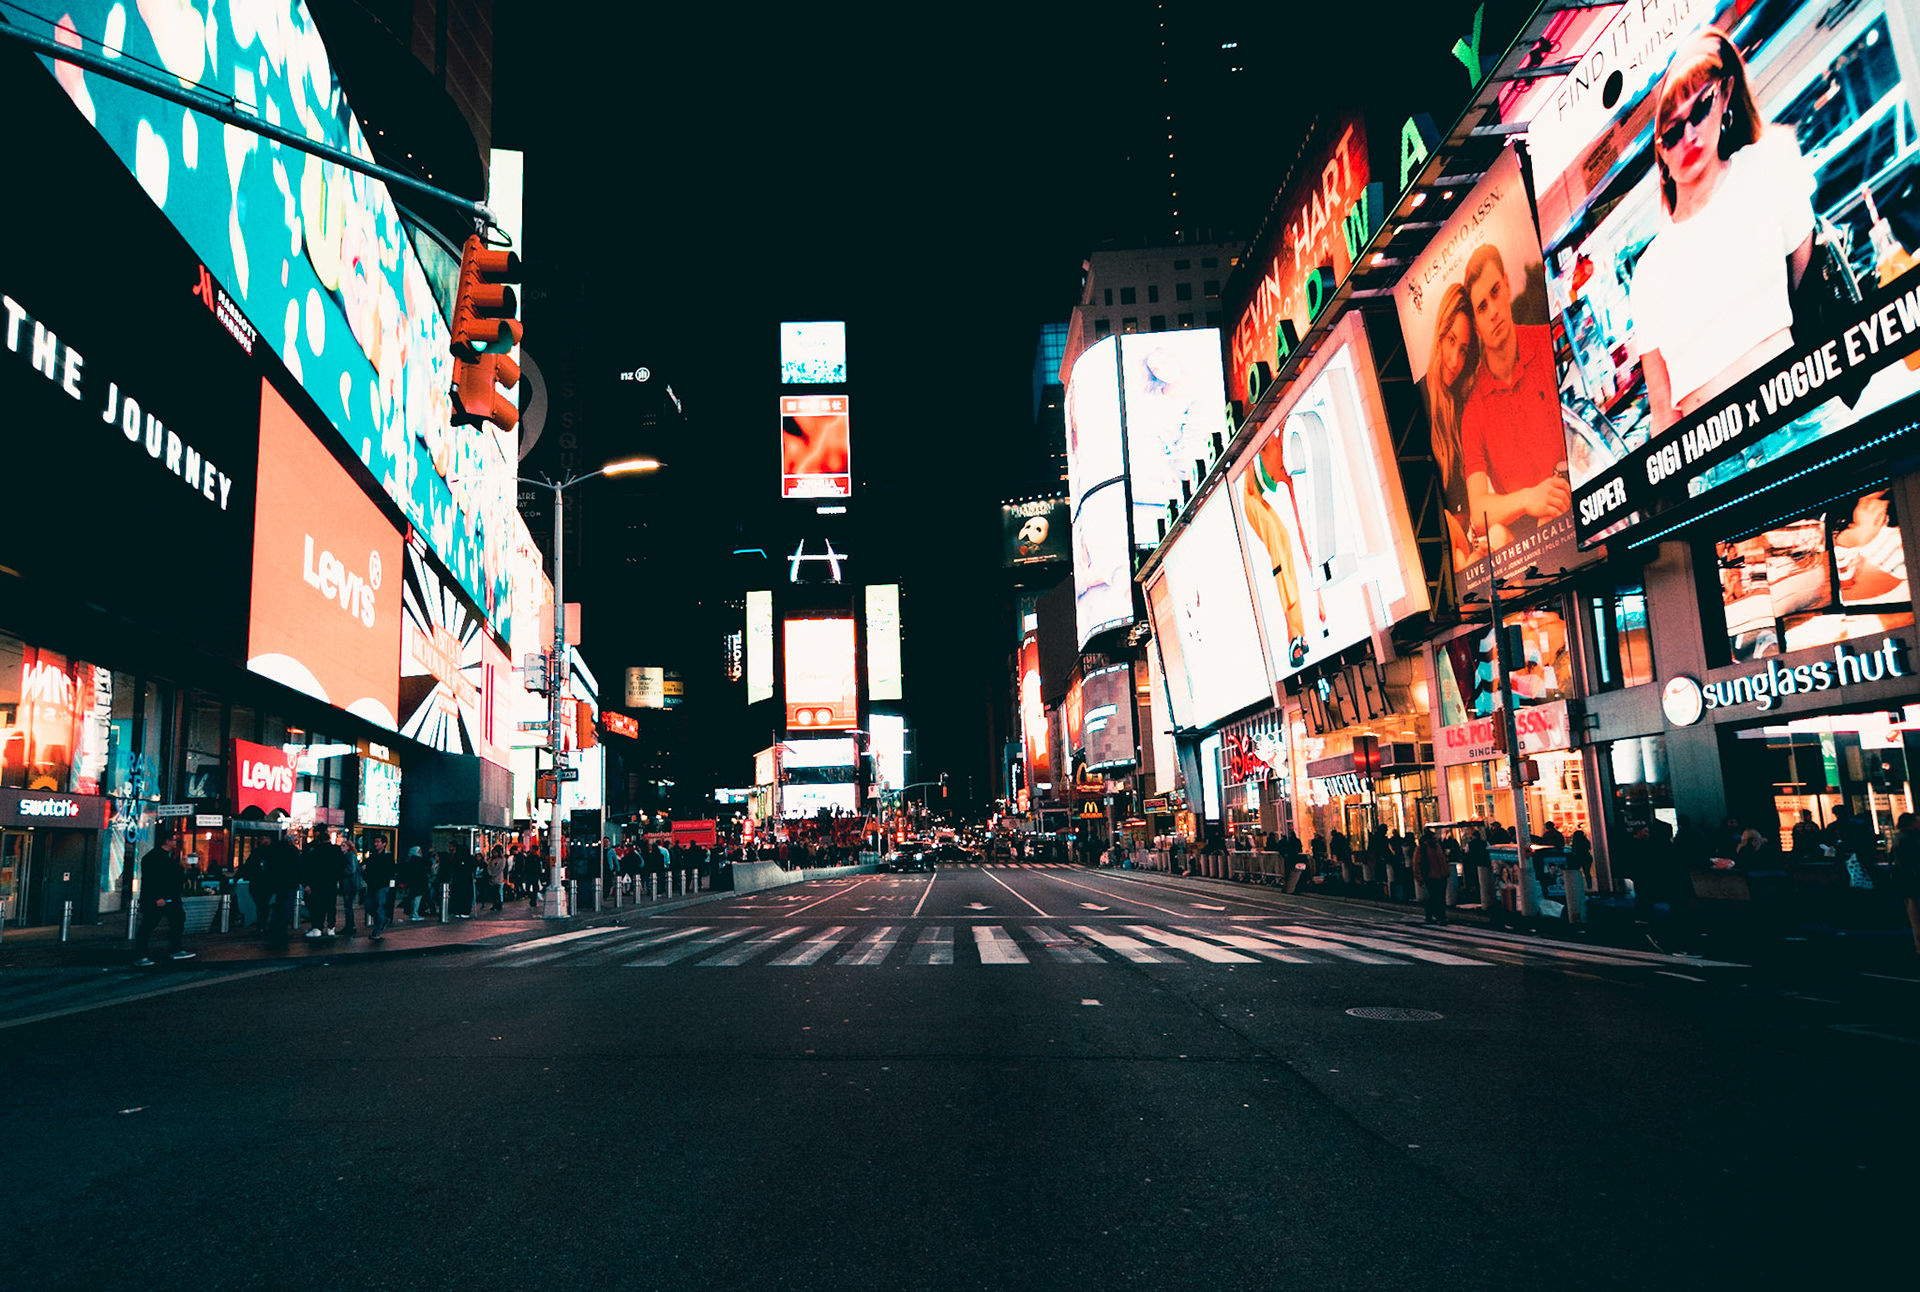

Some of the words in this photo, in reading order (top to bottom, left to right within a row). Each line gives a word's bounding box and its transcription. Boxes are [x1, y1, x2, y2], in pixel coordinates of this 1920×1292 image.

[1557, 51, 1604, 122] FIND
[1612, 12, 1632, 56] IT
[1231, 256, 1282, 376] KEVIN
[1292, 122, 1354, 271] HART
[1441, 224, 1470, 263] POLO
[1471, 186, 1504, 231] ASSN.
[217, 289, 258, 343] MARRIOTT
[3, 295, 84, 401] THE
[103, 382, 232, 510] JOURNEY
[1579, 476, 1627, 526] SUPER
[1646, 446, 1684, 486] GIGI
[1682, 403, 1744, 464] HADID
[1759, 340, 1843, 415] VOGUE
[1465, 563, 1485, 580] LIVE
[1491, 515, 1574, 568] UTHENTICALL
[1702, 660, 1833, 711] sunglass
[1834, 637, 1903, 686] hut
[1446, 731, 1469, 748] U.S.
[1470, 722, 1495, 743] POL
[1469, 747, 1496, 758] SINCE
[19, 798, 71, 817] swatch
